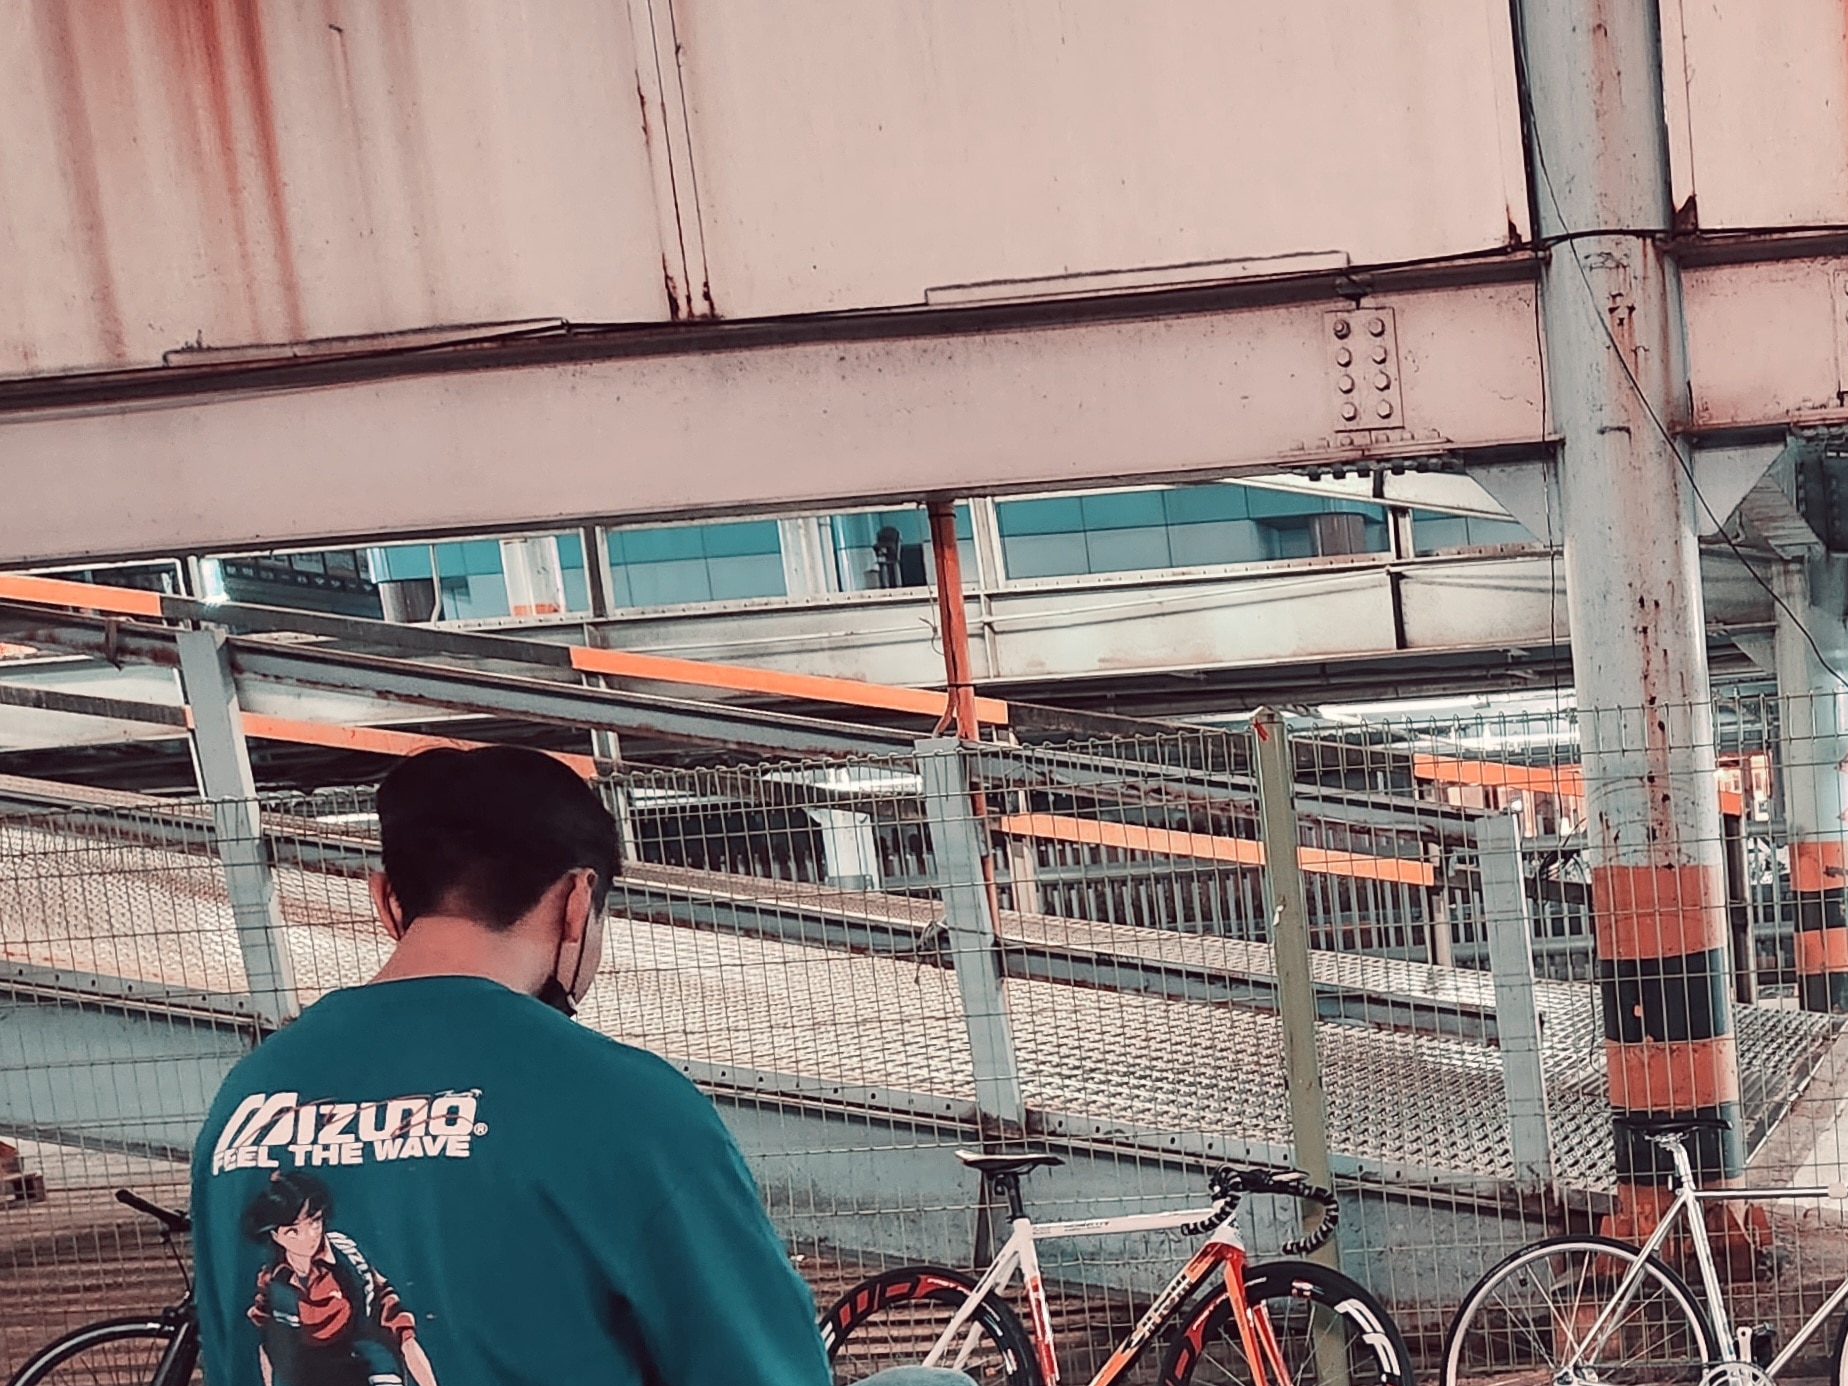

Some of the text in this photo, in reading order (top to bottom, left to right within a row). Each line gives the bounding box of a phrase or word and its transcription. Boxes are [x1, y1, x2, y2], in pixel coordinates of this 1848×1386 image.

[212, 1135, 471, 1176] FEEL THE WAVE
